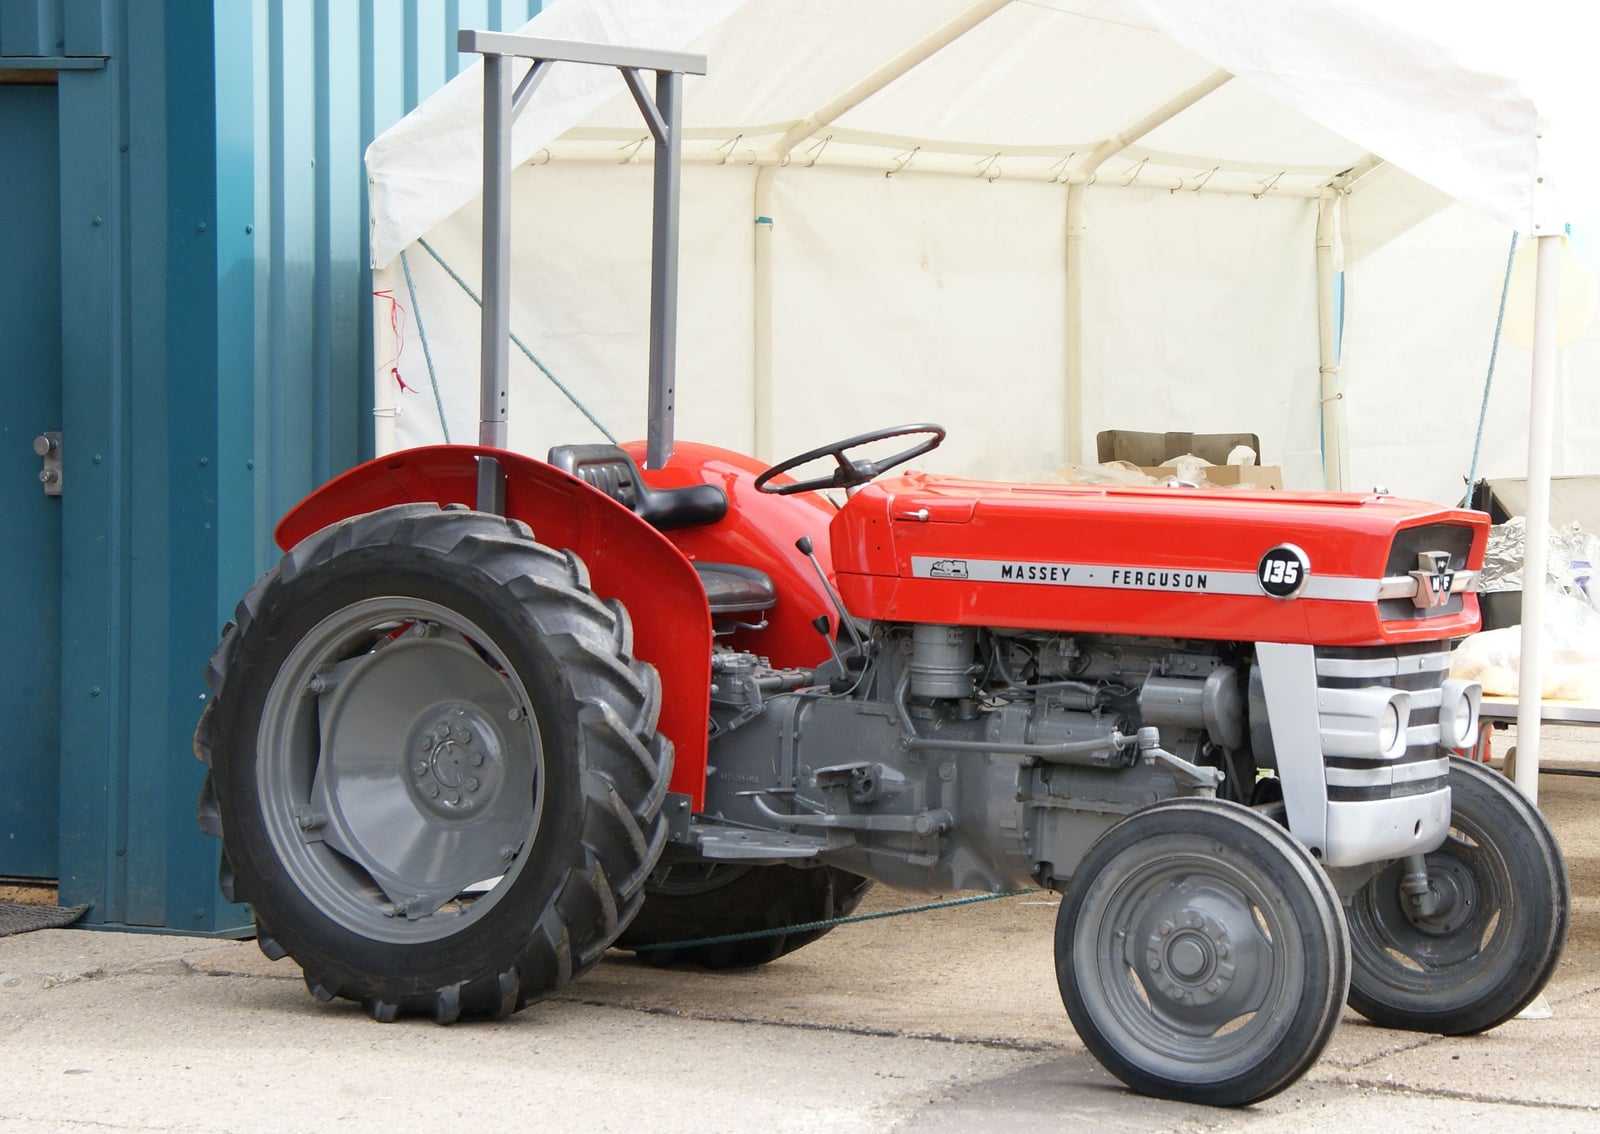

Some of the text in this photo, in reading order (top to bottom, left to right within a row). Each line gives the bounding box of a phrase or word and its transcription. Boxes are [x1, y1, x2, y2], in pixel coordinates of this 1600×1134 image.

[1001, 565, 1207, 589] MASSEY FERGUSON
[1263, 559, 1300, 584] 135
